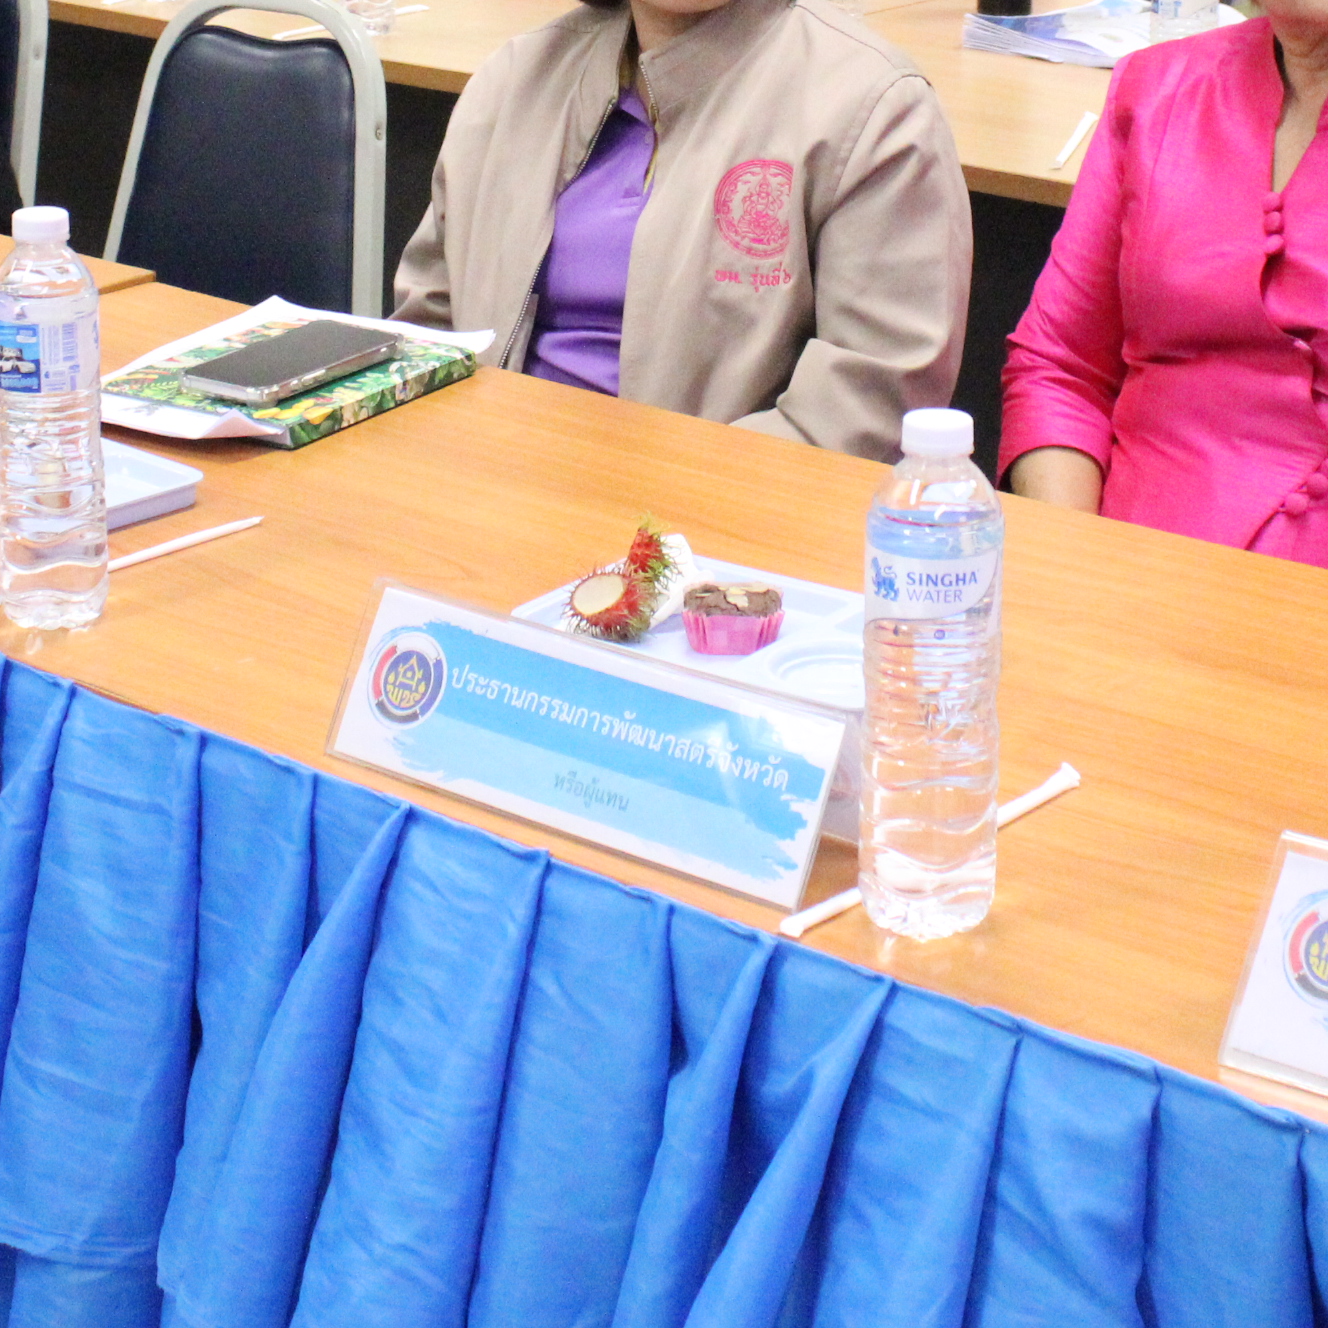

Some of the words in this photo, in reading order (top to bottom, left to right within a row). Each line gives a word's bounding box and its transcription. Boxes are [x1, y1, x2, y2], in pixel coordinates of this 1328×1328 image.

[906, 571, 978, 588] SINGHA
[906, 588, 964, 604] WATER
[451, 664, 789, 791] ประธานกรรมการพัฒนาสตรีจังหวัด
[553, 770, 630, 812] หรือผู้แทน
